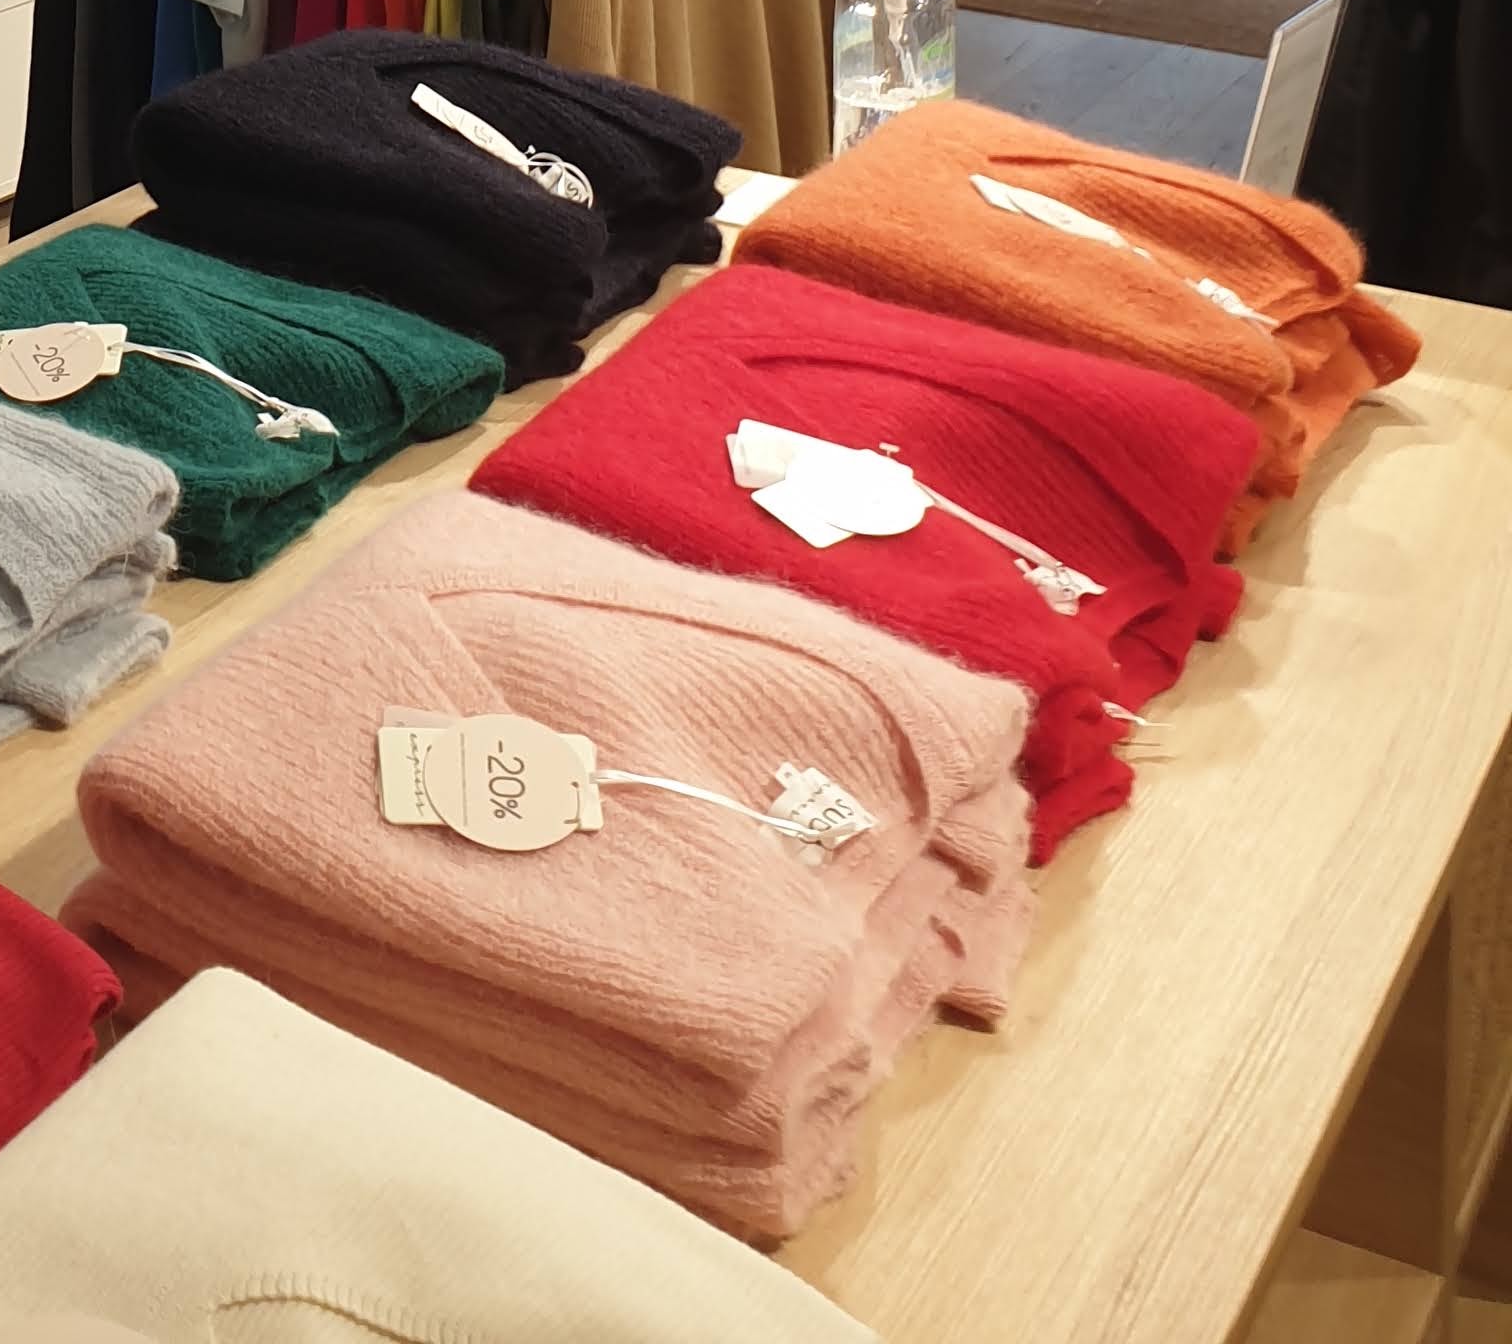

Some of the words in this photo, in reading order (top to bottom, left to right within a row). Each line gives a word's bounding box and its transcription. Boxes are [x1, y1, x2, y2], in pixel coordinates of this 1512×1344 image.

[32, 344, 70, 383] -20%
[405, 732, 426, 817] express
[487, 740, 526, 820] -20%
